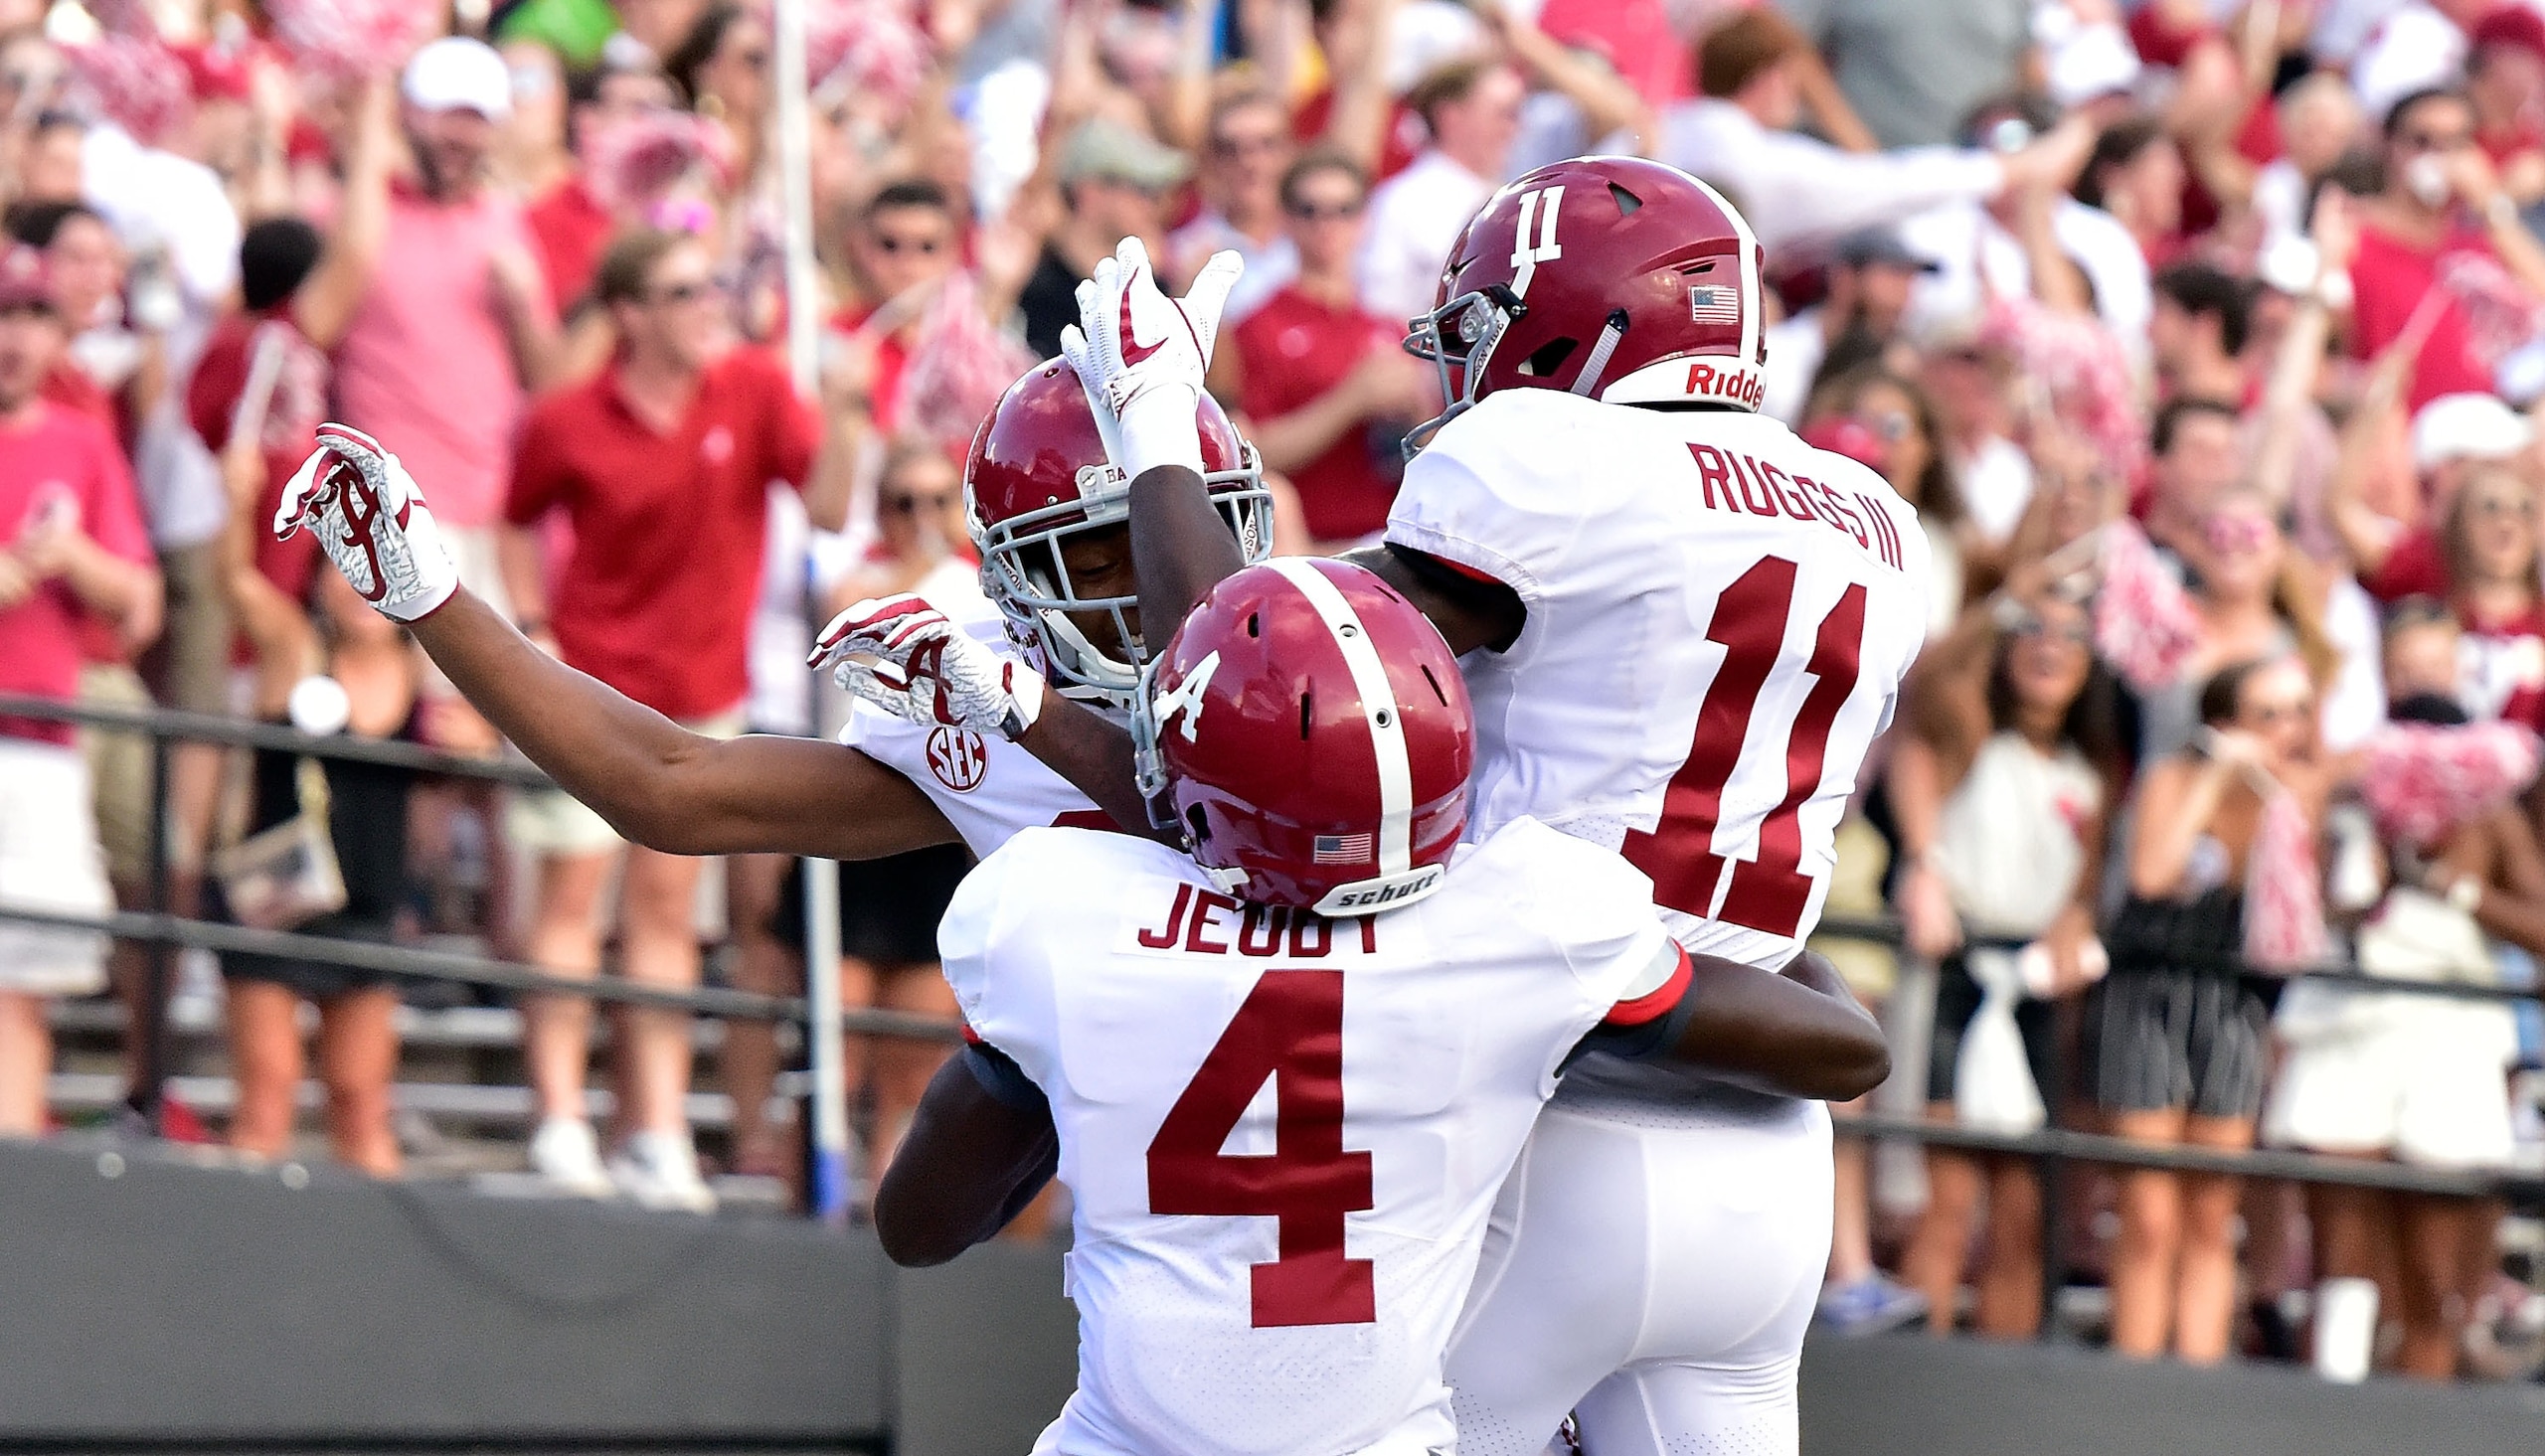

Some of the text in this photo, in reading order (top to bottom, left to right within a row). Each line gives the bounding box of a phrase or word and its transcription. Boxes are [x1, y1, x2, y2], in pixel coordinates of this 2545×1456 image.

[1510, 185, 1566, 267] 11
[1685, 364, 1766, 408] Ridde
[1104, 466, 1128, 484] BA
[1685, 441, 1905, 572] RUGGS III
[930, 727, 984, 787] SEC
[1619, 554, 1869, 939] 11
[1338, 871, 1440, 906] schutt
[1145, 969, 1378, 1329] 4
